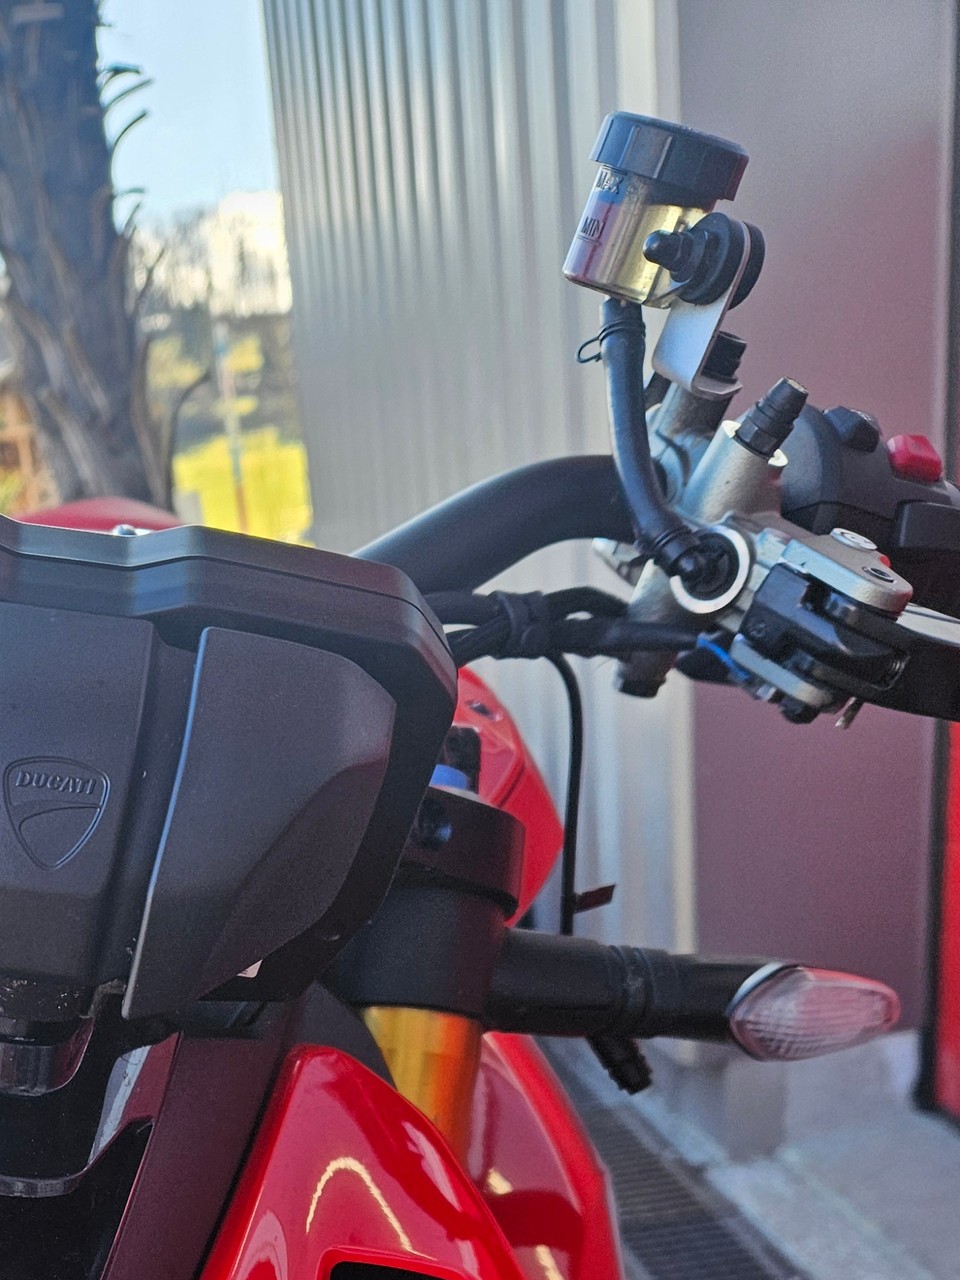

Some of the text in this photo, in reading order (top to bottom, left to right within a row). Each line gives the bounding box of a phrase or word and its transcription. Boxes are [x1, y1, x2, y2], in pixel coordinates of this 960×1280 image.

[596, 170, 625, 195] MAX
[580, 216, 606, 240] MIN
[15, 771, 97, 795] DUCATI
